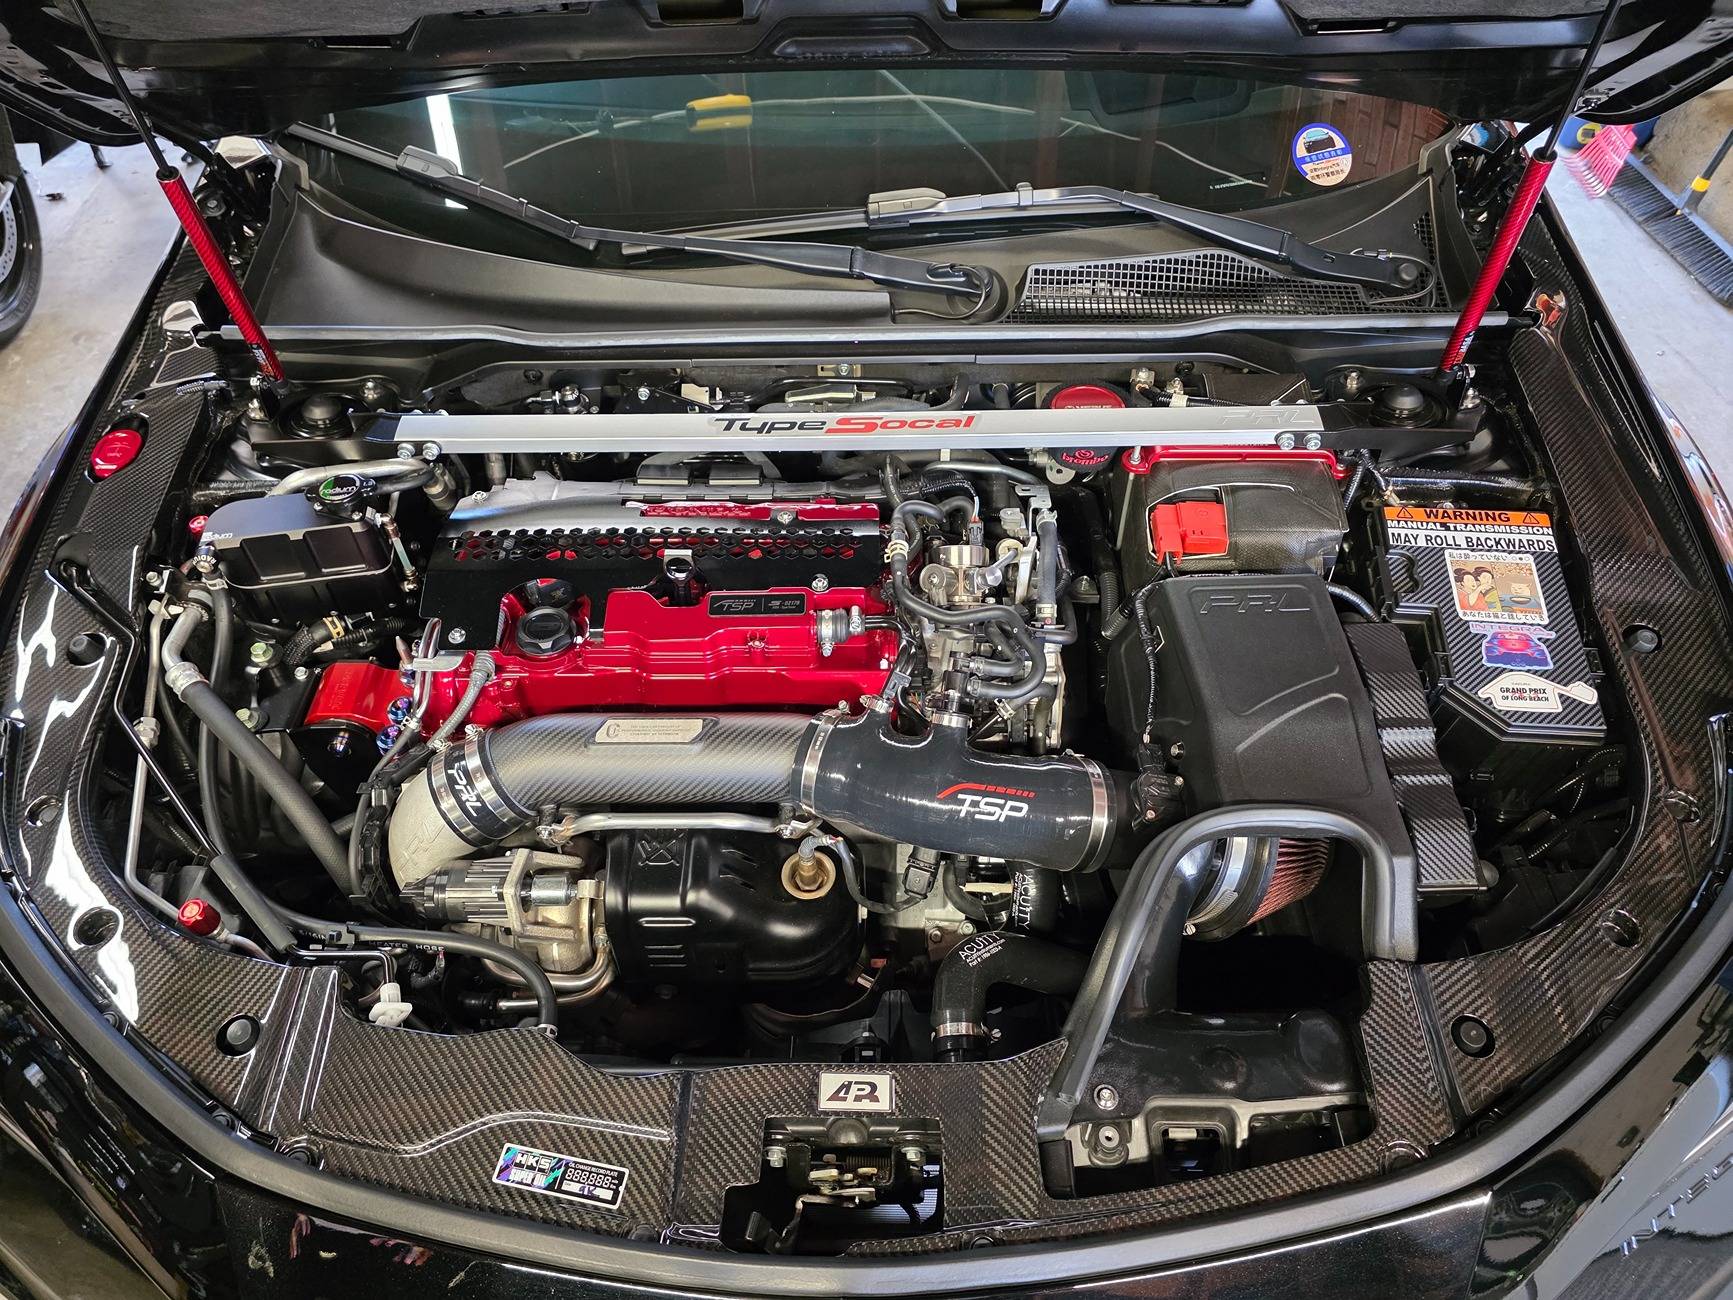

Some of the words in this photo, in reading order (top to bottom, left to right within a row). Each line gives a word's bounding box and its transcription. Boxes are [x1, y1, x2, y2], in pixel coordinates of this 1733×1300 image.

[714, 418, 827, 434] Type
[824, 415, 975, 434] Socal
[1222, 409, 1316, 425] PRL
[321, 485, 357, 495] radium
[1423, 508, 1511, 522] WARNING
[1387, 520, 1446, 531] MANUAL
[1449, 523, 1553, 535] TRANSMISSION
[1391, 532, 1420, 546] MAY
[1425, 534, 1462, 548] ROLL
[1465, 536, 1555, 552] BACKWARDS
[722, 602, 755, 611] TSP
[1200, 594, 1310, 613] PRL
[1471, 623, 1546, 634] INTEGRA
[1499, 686, 1527, 694] GRAND
[1529, 687, 1548, 695] PRIX
[447, 760, 482, 817] PRL
[957, 794, 1029, 823] TSP
[369, 941, 409, 949] HEATER
[415, 944, 445, 952] HOSE
[516, 1152, 551, 1170] HKS
[509, 1168, 534, 1185] SUPER
[576, 1163, 591, 1172] CHANGE
[591, 1166, 606, 1175] RECORD
[605, 1169, 618, 1177] PLATE
